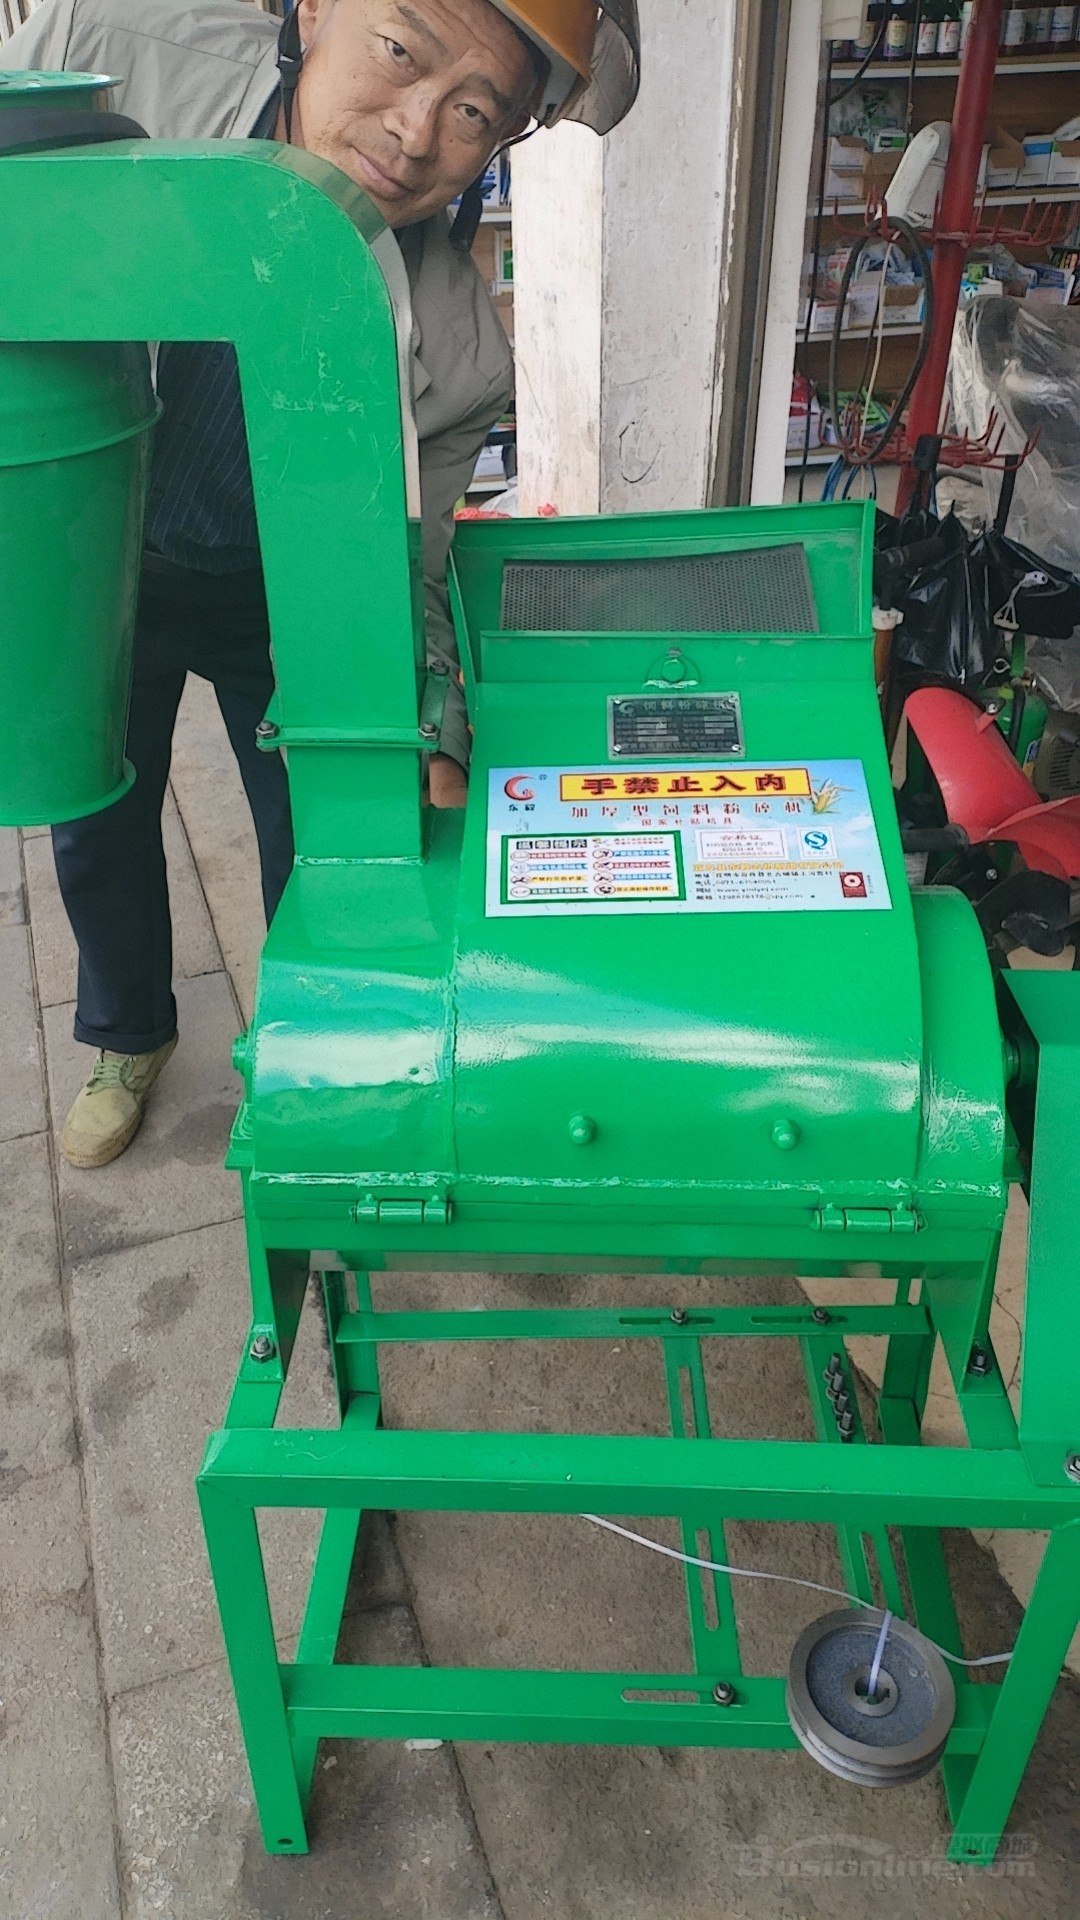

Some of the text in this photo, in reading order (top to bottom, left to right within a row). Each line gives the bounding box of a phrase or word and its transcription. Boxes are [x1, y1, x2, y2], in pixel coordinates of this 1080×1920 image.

[581, 773, 787, 795] 手禁止入内
[571, 801, 802, 817] 加厚型饲料粉碎机
